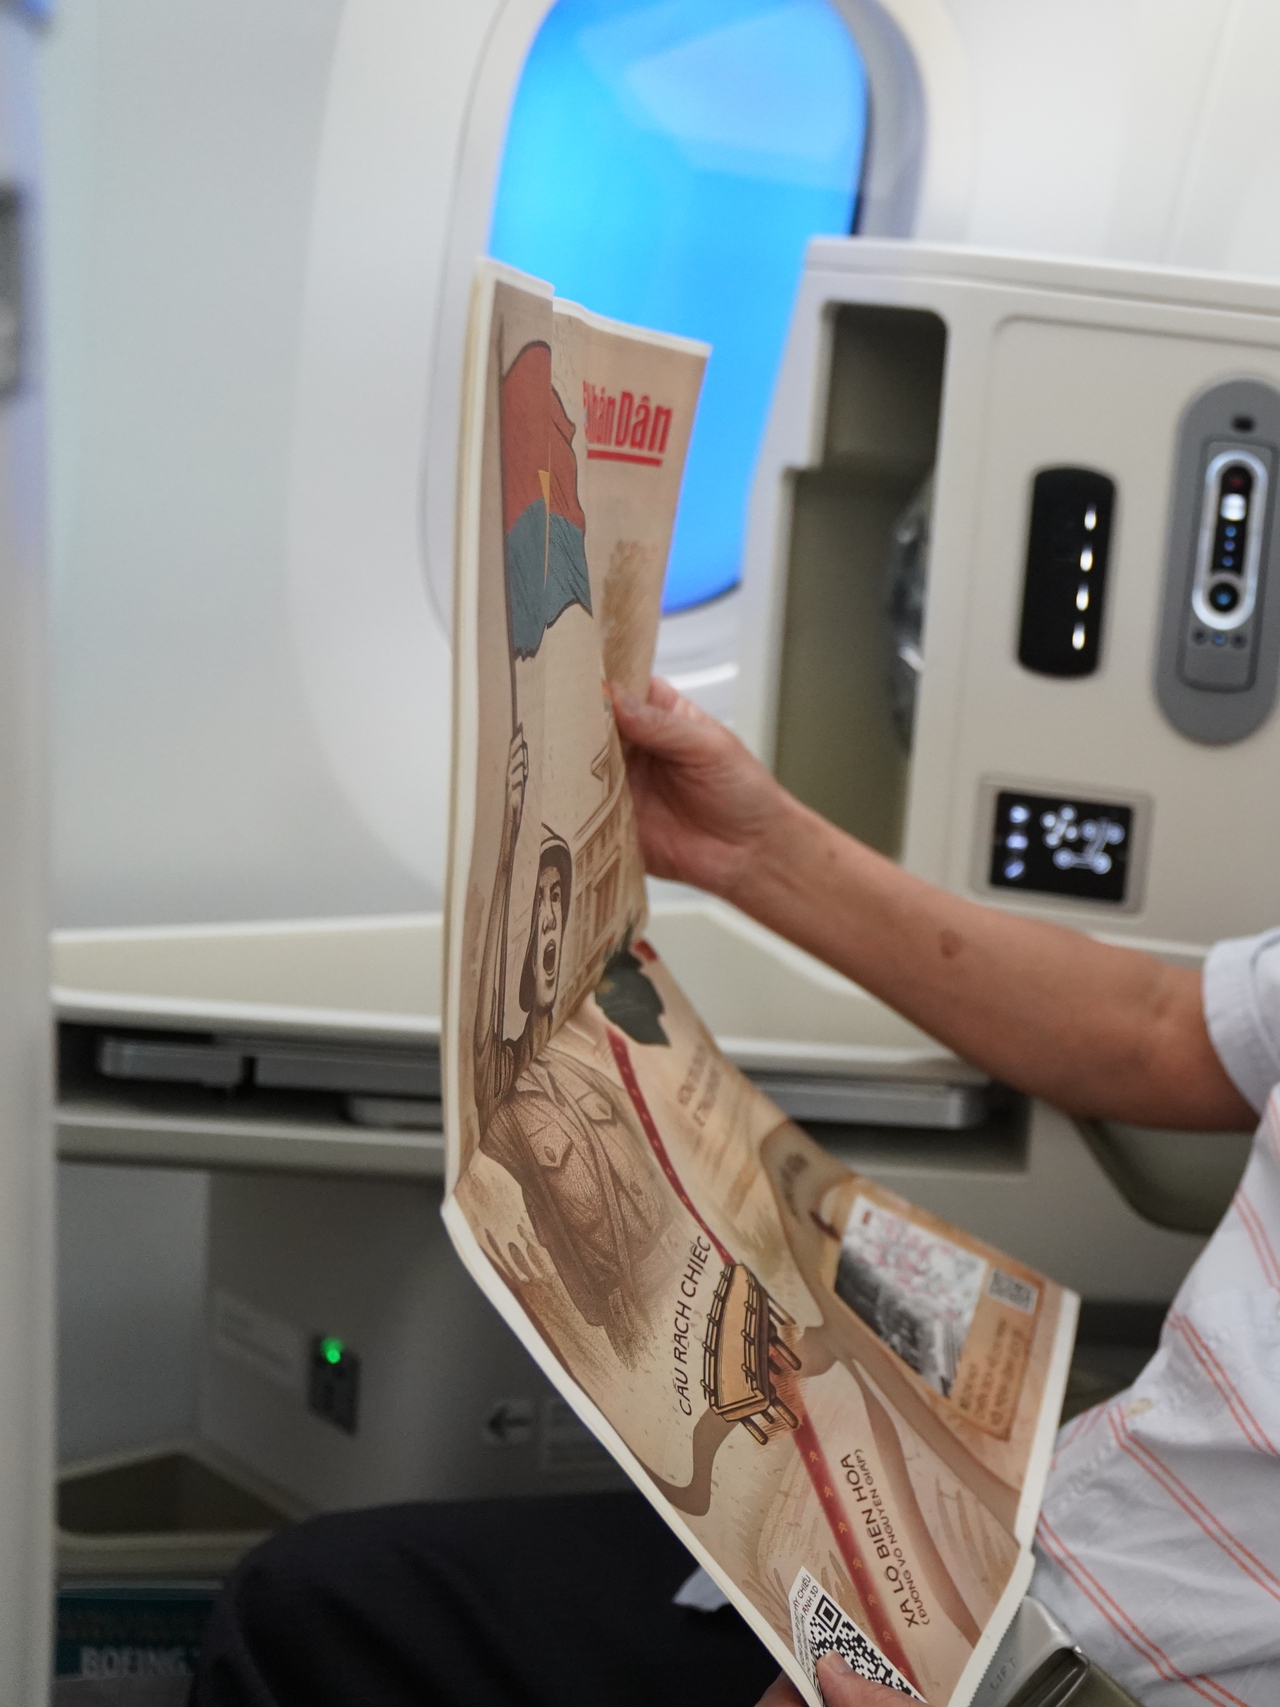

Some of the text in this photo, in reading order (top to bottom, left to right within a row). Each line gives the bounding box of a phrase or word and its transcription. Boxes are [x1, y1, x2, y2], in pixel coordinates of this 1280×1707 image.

[614, 391, 673, 454] Dân
[809, 1585, 819, 1598] 3D
[900, 1599, 920, 1629] XA
